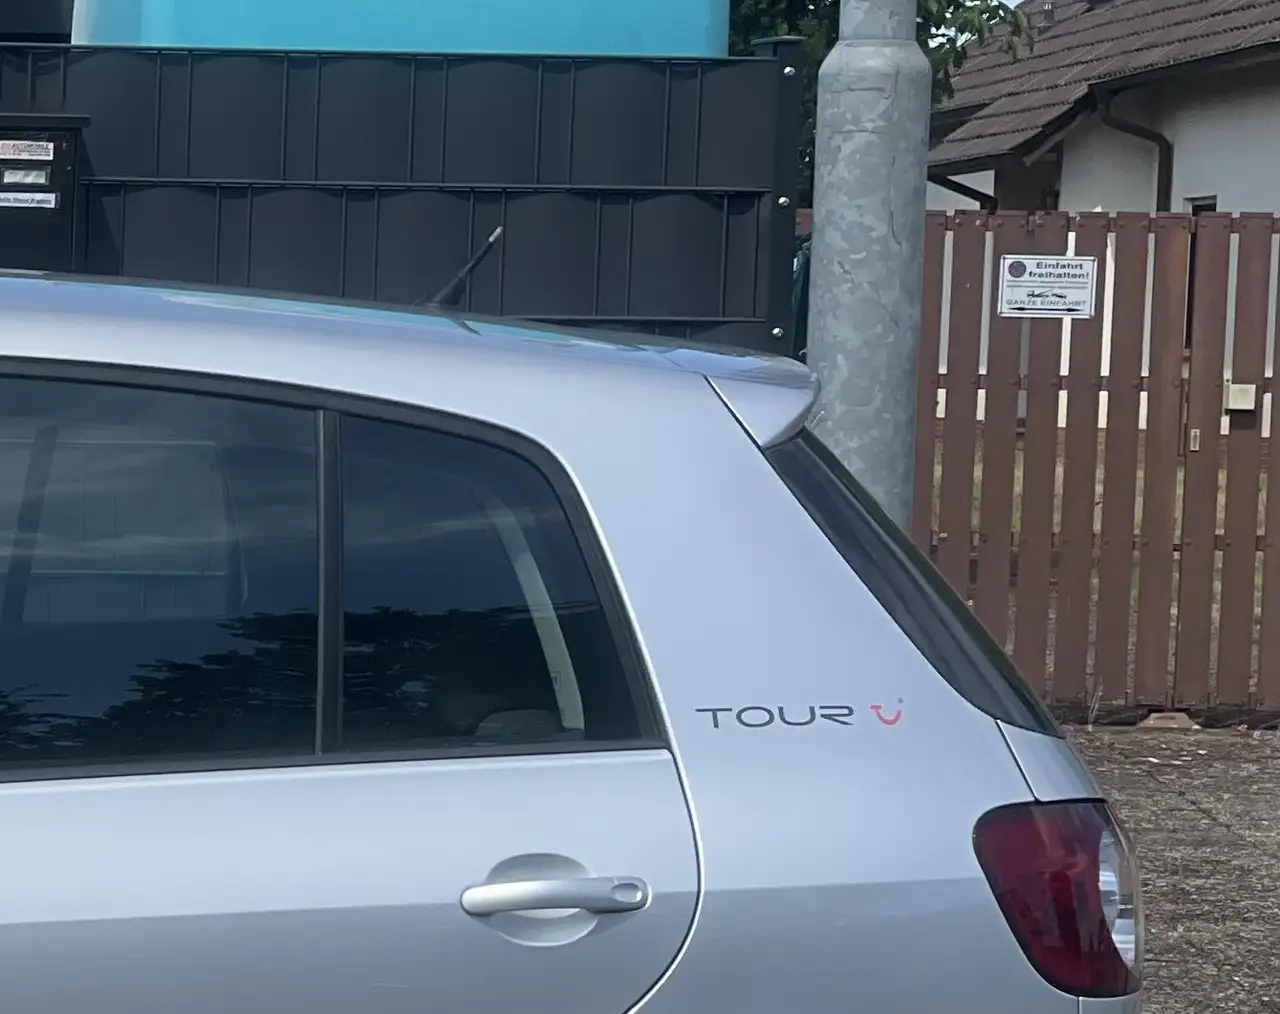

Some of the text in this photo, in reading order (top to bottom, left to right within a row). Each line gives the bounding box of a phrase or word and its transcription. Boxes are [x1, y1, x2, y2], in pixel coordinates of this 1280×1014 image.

[1036, 261, 1083, 270] Einfahrt
[1028, 271, 1089, 279] freihalten!
[694, 705, 855, 729] TOUR
